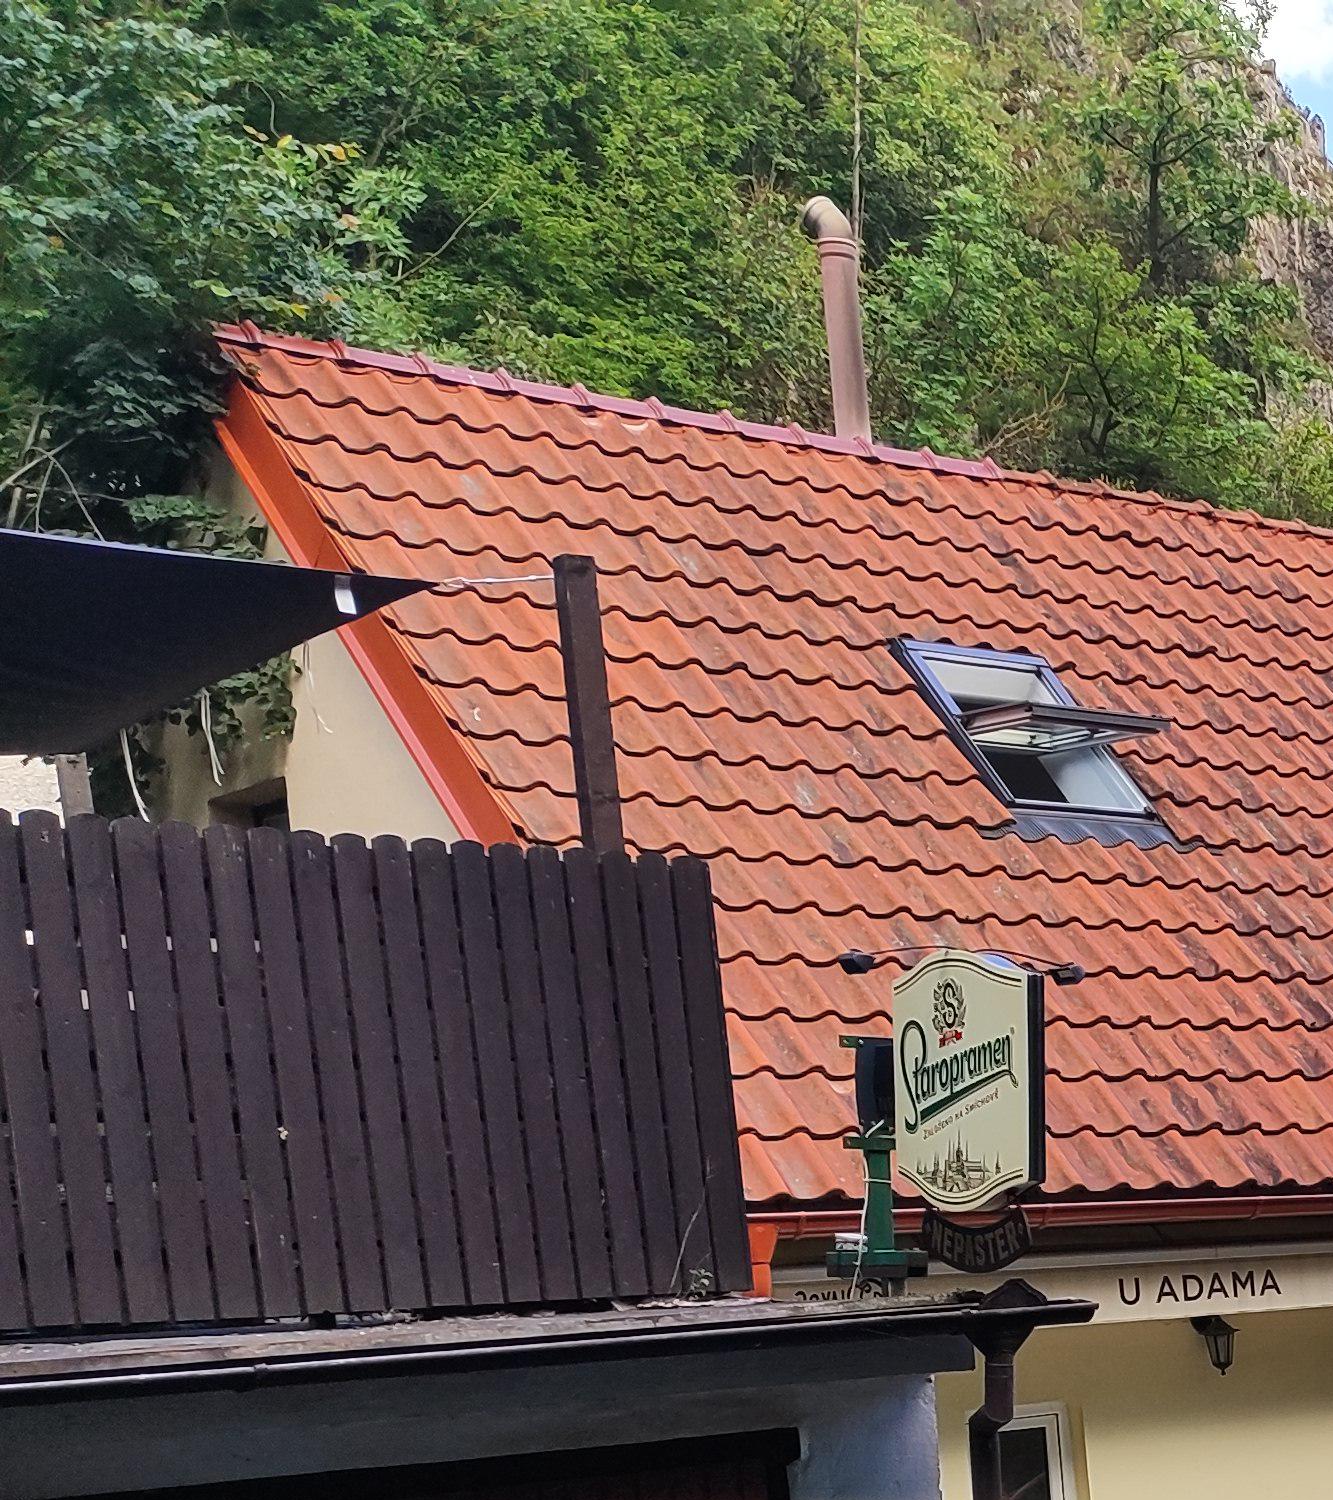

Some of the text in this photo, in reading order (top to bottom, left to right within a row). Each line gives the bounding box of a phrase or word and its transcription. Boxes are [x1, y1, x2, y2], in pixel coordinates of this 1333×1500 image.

[901, 1020, 1018, 1133] Staropramen
[931, 1220, 1020, 1266] NEPASTER
[1118, 1269, 1282, 1306] U ADAMA
